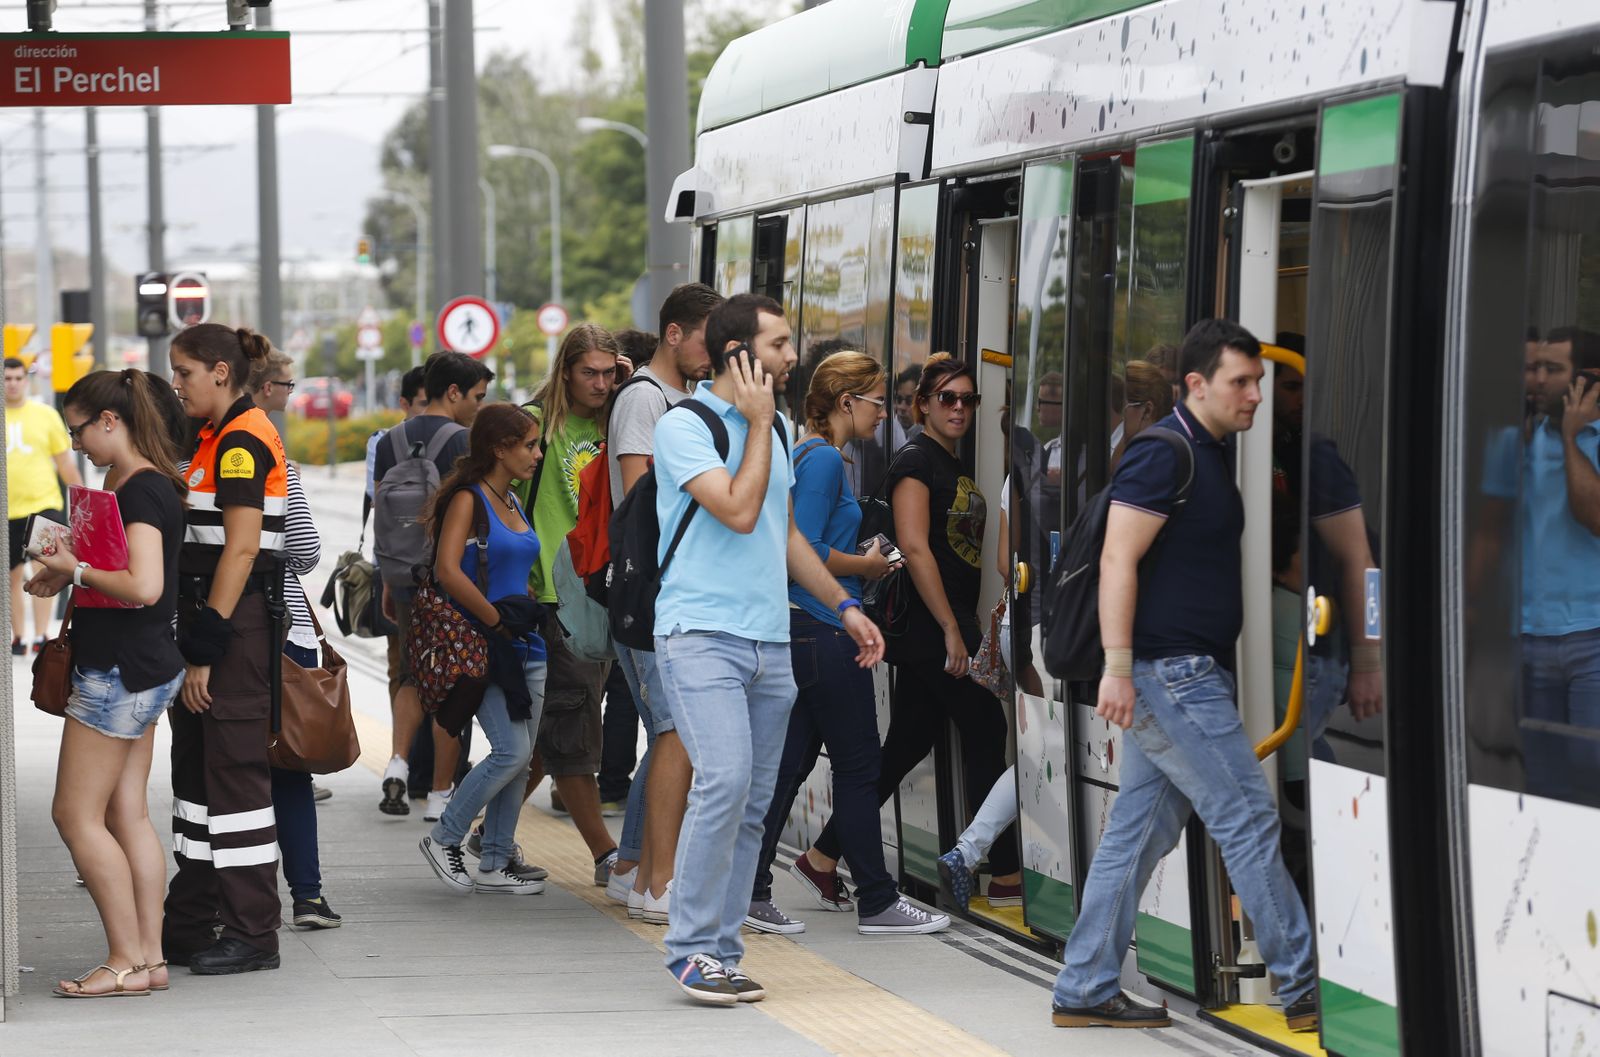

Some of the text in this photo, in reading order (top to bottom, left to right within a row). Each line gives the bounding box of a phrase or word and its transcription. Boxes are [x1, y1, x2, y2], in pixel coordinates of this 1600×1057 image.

[14, 44, 77, 58] dirección
[14, 66, 160, 93] El Perchel
